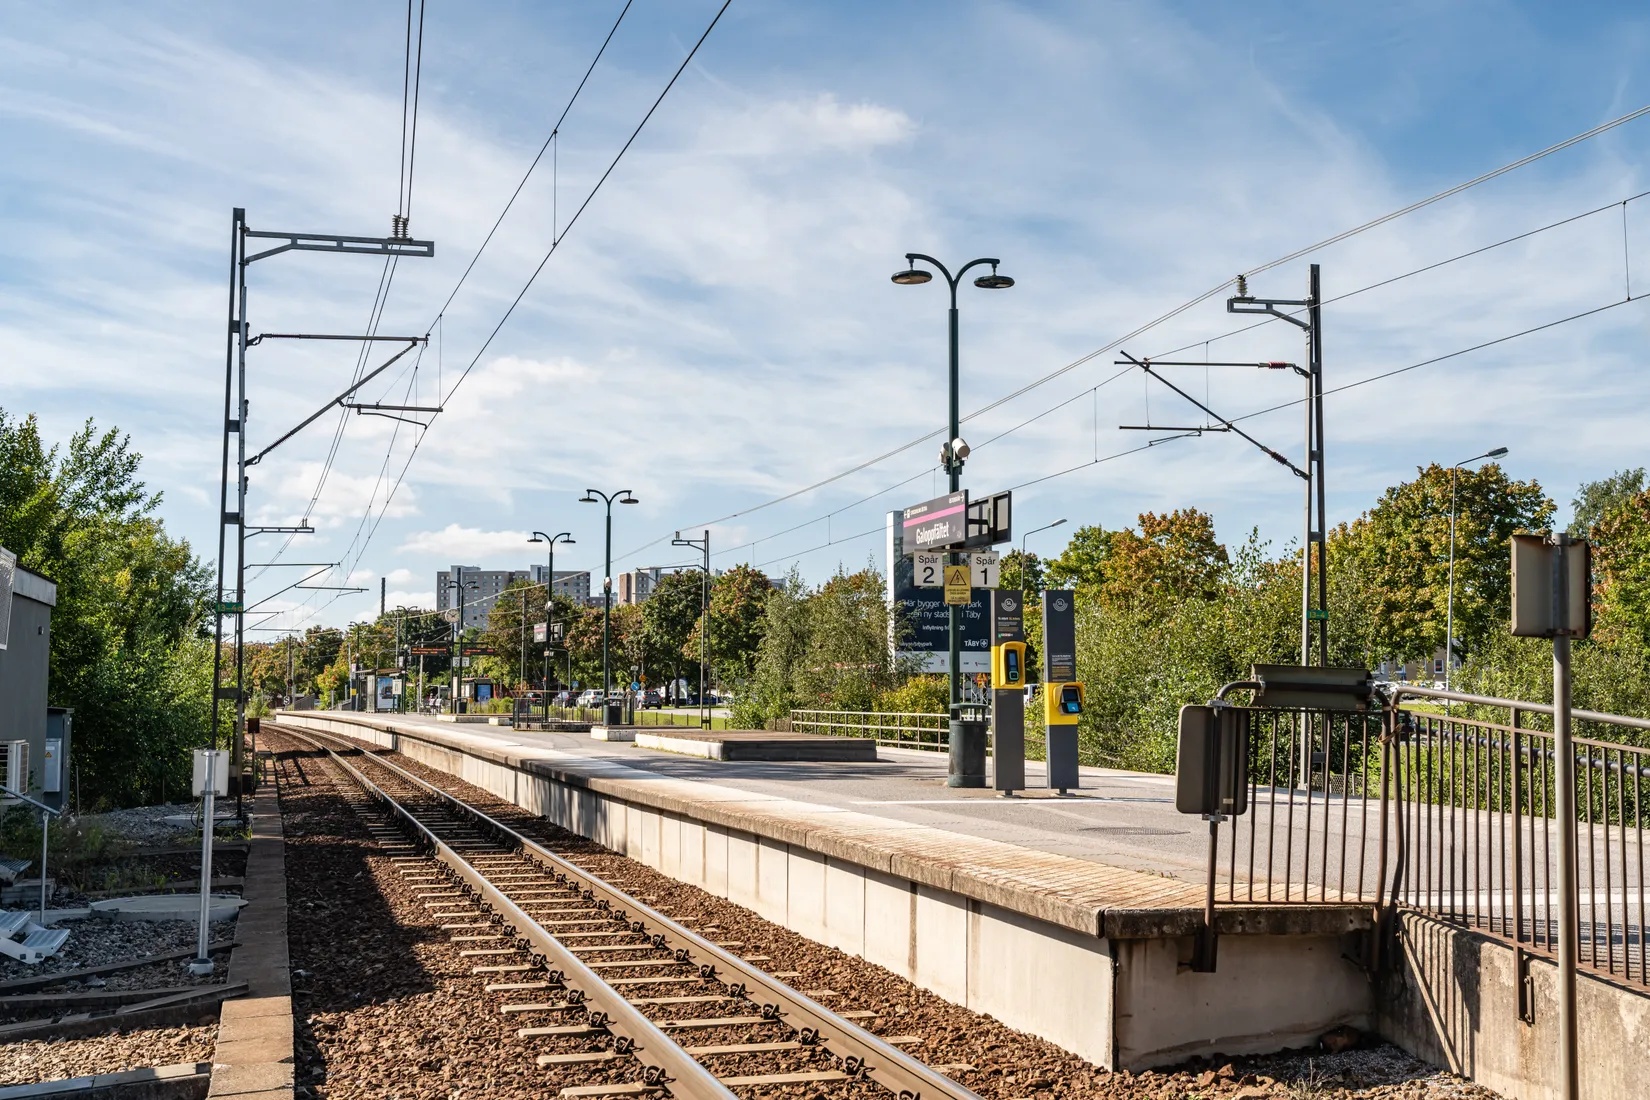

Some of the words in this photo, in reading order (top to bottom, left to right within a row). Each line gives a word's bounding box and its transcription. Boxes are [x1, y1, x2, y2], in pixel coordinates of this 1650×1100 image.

[916, 521, 949, 545] Galoppfältet
[918, 554, 938, 565] Spår
[976, 556, 996, 566] Spår
[922, 566, 935, 584] 2
[980, 567, 988, 585] 1
[917, 600, 940, 609] bygger
[923, 611, 932, 619] ny
[934, 610, 950, 618] stads
[965, 610, 981, 620] Täby
[964, 639, 980, 647] TÄBY
